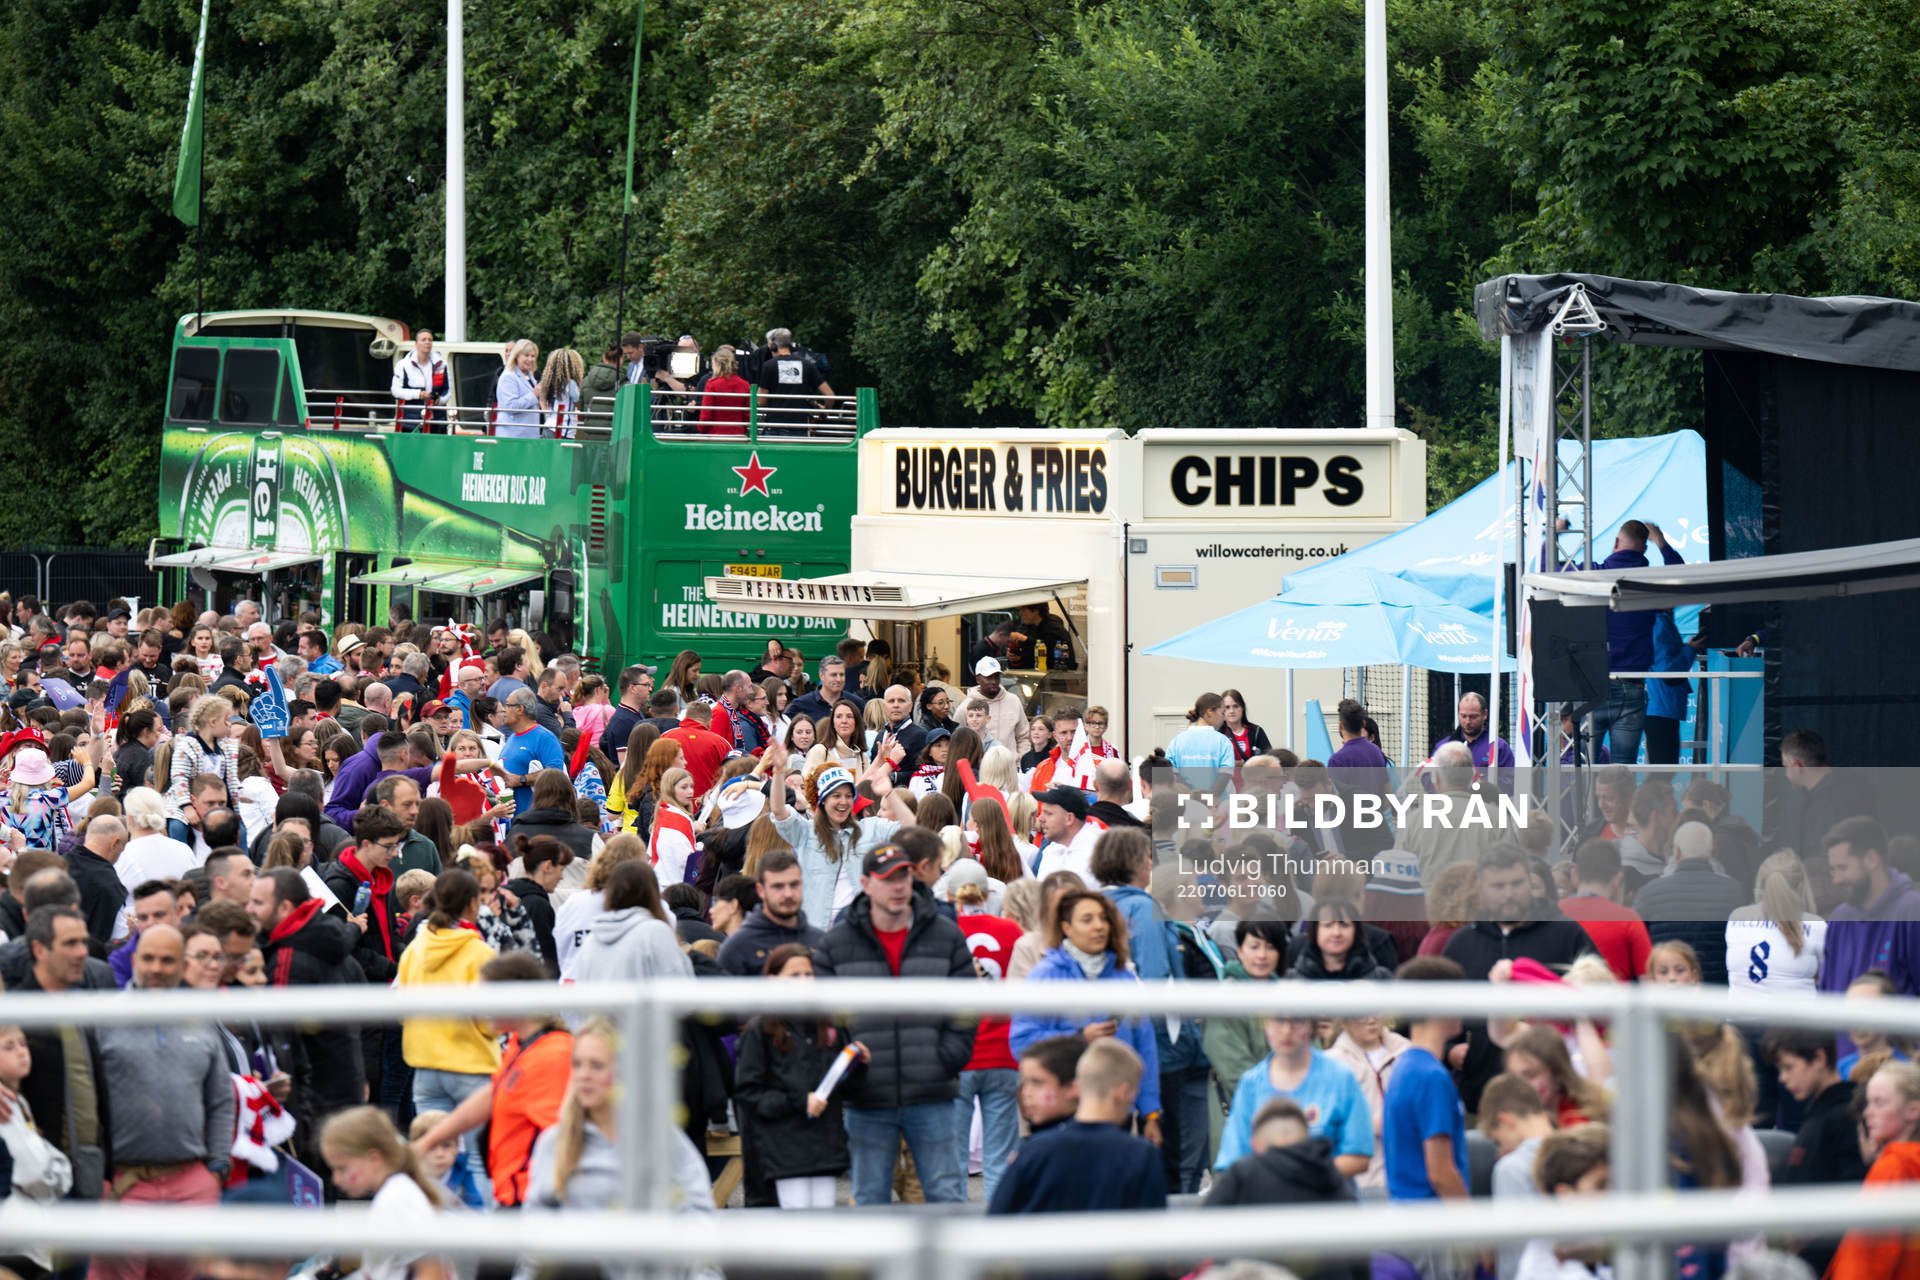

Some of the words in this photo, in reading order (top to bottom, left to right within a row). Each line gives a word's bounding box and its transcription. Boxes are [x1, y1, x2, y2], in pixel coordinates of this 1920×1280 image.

[473, 452, 485, 471] THE
[462, 473, 510, 503] HEINEKEN
[510, 475, 527, 505] BUS
[528, 476, 546, 506] BAR
[896, 446, 996, 510] BURGER
[1004, 446, 1023, 512] &
[1031, 447, 1108, 514] FRIES
[1170, 455, 1364, 507] CHIPS
[684, 503, 824, 532] Heineken
[1196, 543, 1349, 561] willowcatering.co.uk
[759, 566, 781, 578] JAR
[682, 586, 704, 602] THE
[746, 580, 873, 602] REFRESHMENTS
[662, 603, 760, 629] HEINEKEN
[1266, 616, 1344, 642] Venus
[1406, 621, 1479, 646] Venus
[1748, 941, 1770, 984] 8
